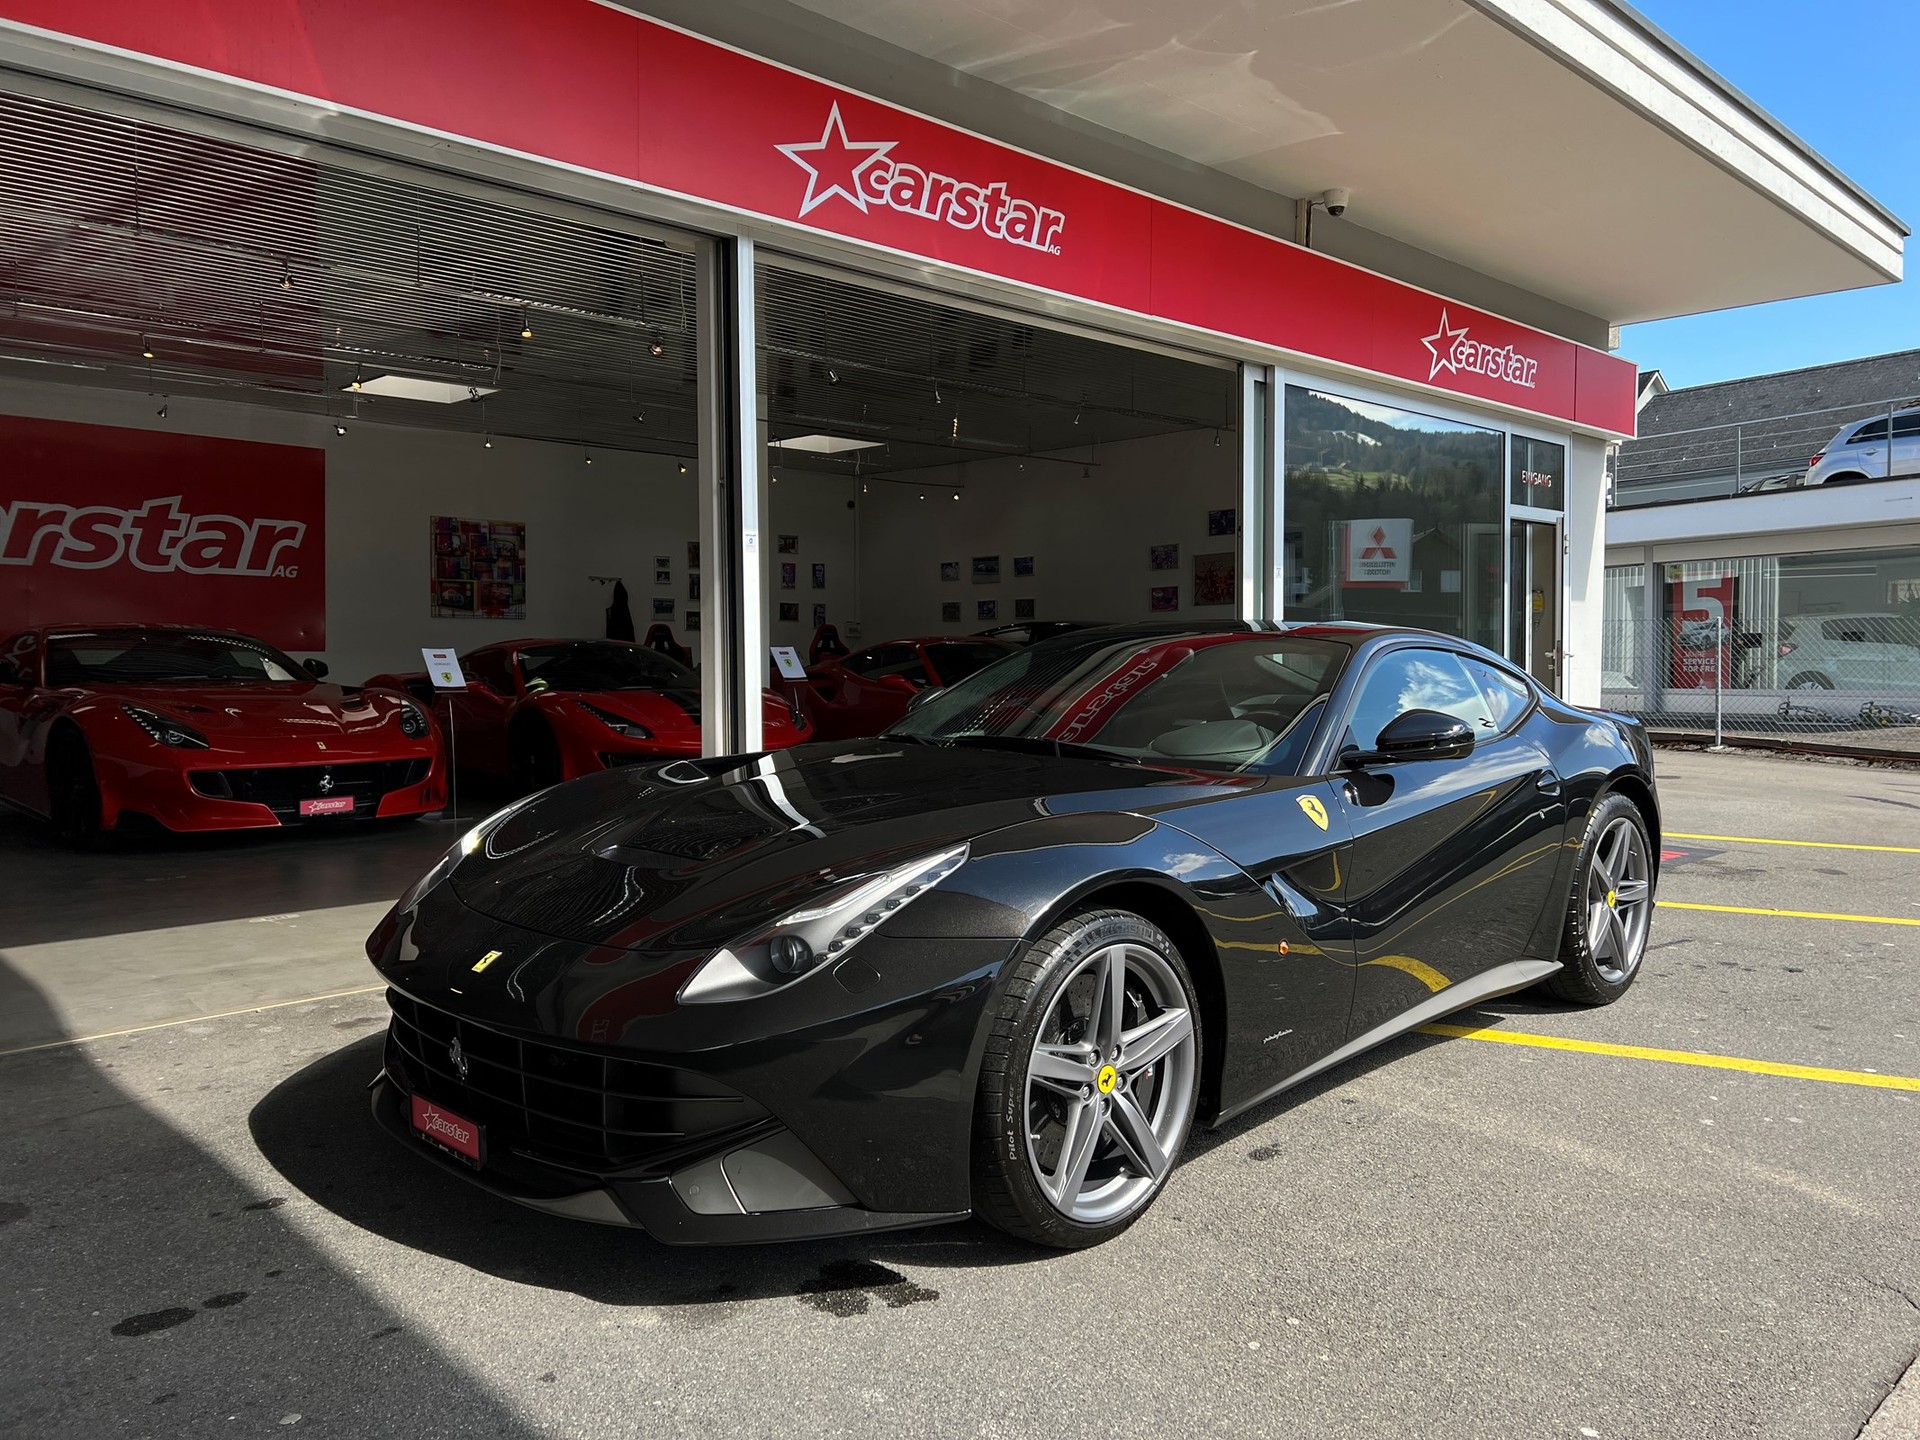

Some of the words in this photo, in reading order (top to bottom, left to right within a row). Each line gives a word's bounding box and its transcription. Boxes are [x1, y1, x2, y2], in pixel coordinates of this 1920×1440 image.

[855, 156, 1066, 252] carstar
[1048, 244, 1061, 255] AG
[1451, 338, 1538, 387] carstar
[1521, 470, 1552, 488] EINGANG
[272, 565, 298, 578] AG
[1683, 574, 1725, 628] 5
[1005, 1083, 1015, 1124] Super
[434, 1118, 470, 1143] carstar
[1006, 1127, 1017, 1160] Pilot
